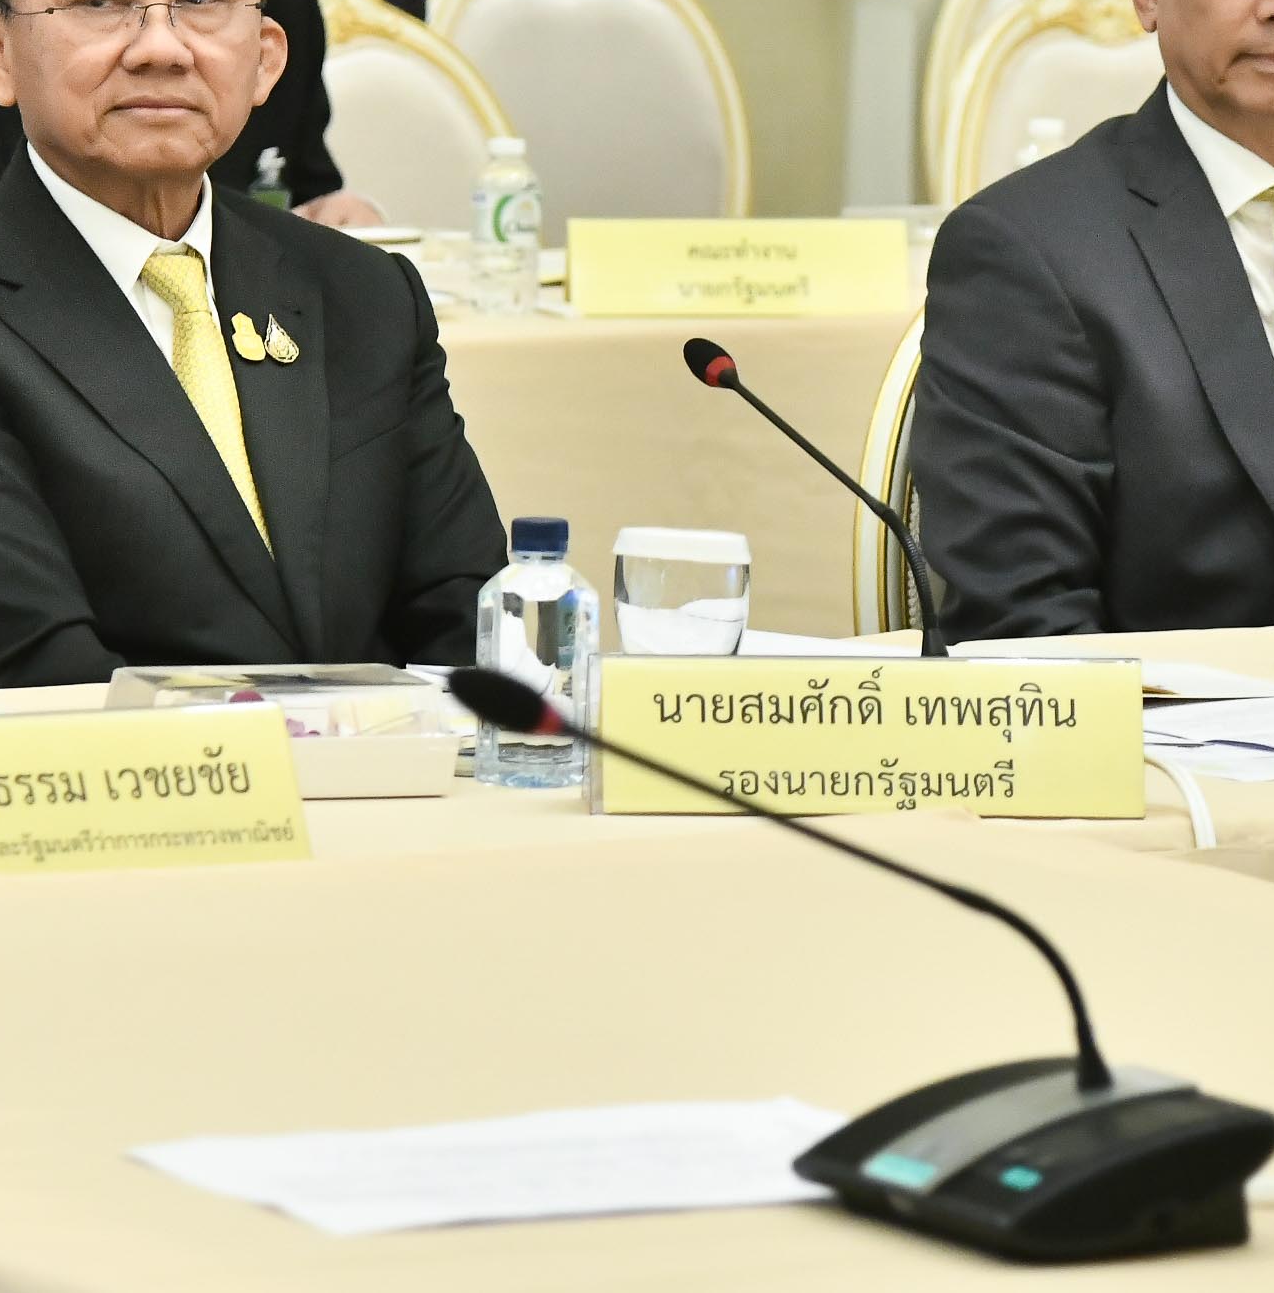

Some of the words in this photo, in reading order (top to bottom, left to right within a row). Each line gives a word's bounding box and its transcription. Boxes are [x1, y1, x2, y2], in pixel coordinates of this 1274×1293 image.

[652, 666, 884, 726] นายสมศักดิ์
[904, 682, 1078, 743] เทพสุทิน
[104, 745, 252, 801] เวชยชัย
[718, 758, 1016, 810] รองนายกรัฐมนตรี
